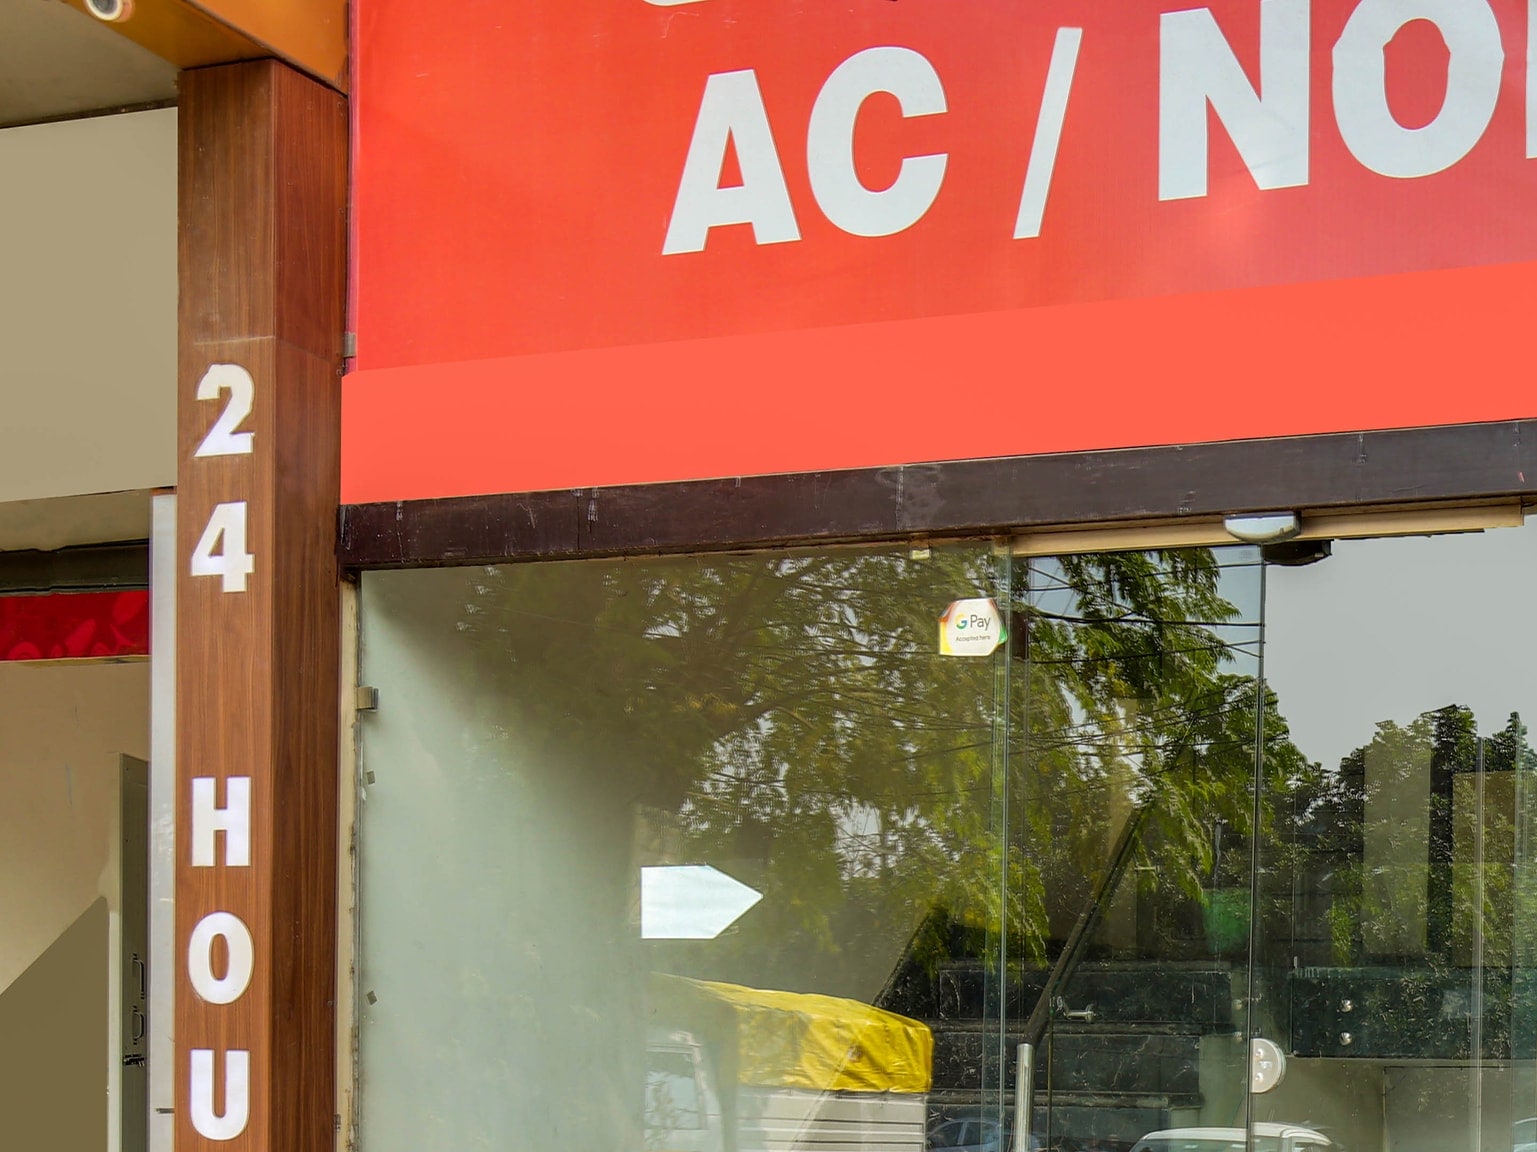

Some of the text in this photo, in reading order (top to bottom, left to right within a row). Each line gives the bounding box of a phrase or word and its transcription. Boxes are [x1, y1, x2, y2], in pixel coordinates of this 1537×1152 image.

[663, 47, 948, 255] AC
[1013, 27, 1083, 239] /
[191, 364, 255, 593] 24
[970, 614, 991, 631] Pay
